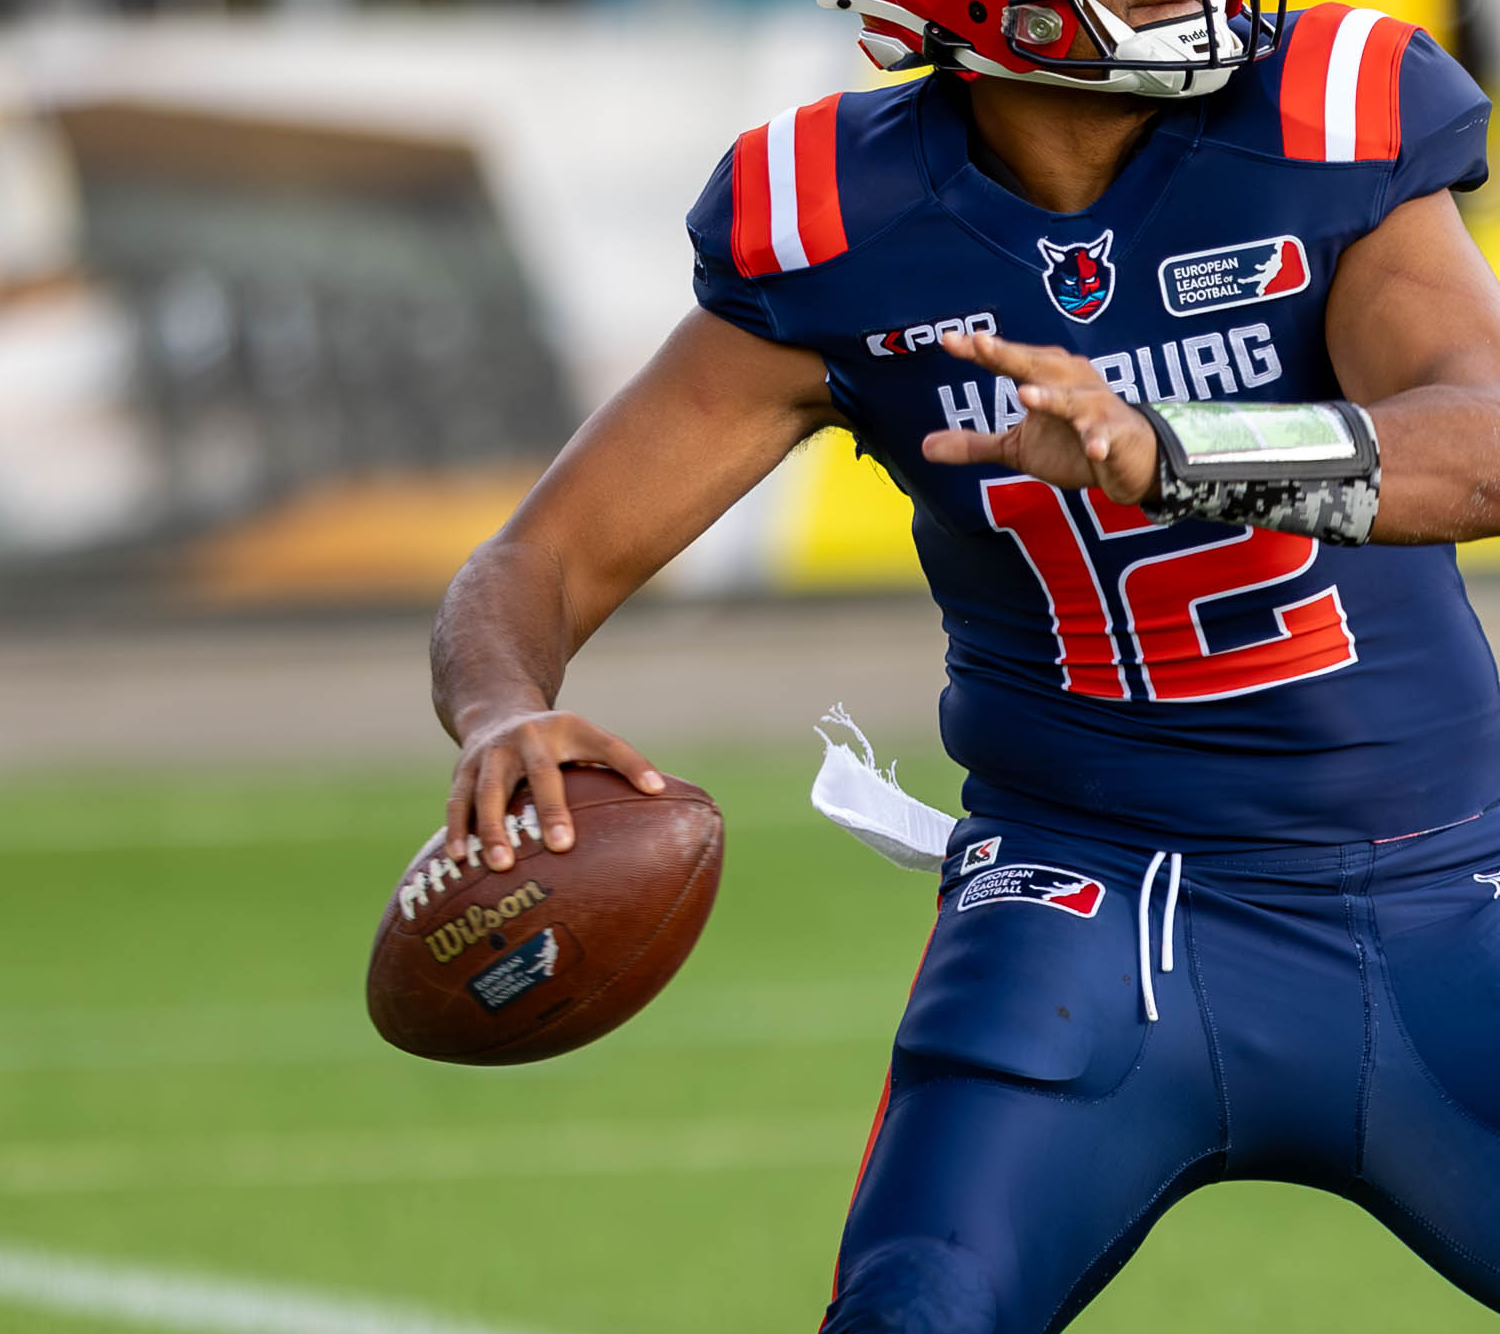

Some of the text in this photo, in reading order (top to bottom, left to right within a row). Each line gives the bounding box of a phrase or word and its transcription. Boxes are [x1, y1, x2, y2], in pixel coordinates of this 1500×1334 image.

[1173, 257, 1239, 280] EUROPEAN
[1176, 273, 1223, 293] LEAGUE
[1179, 283, 1242, 305] FOOTBALL
[937, 322, 1283, 436] HABURG
[980, 474, 1359, 703] 12
[965, 885, 1022, 904] FOOTBALL
[425, 880, 548, 963] Wilson
